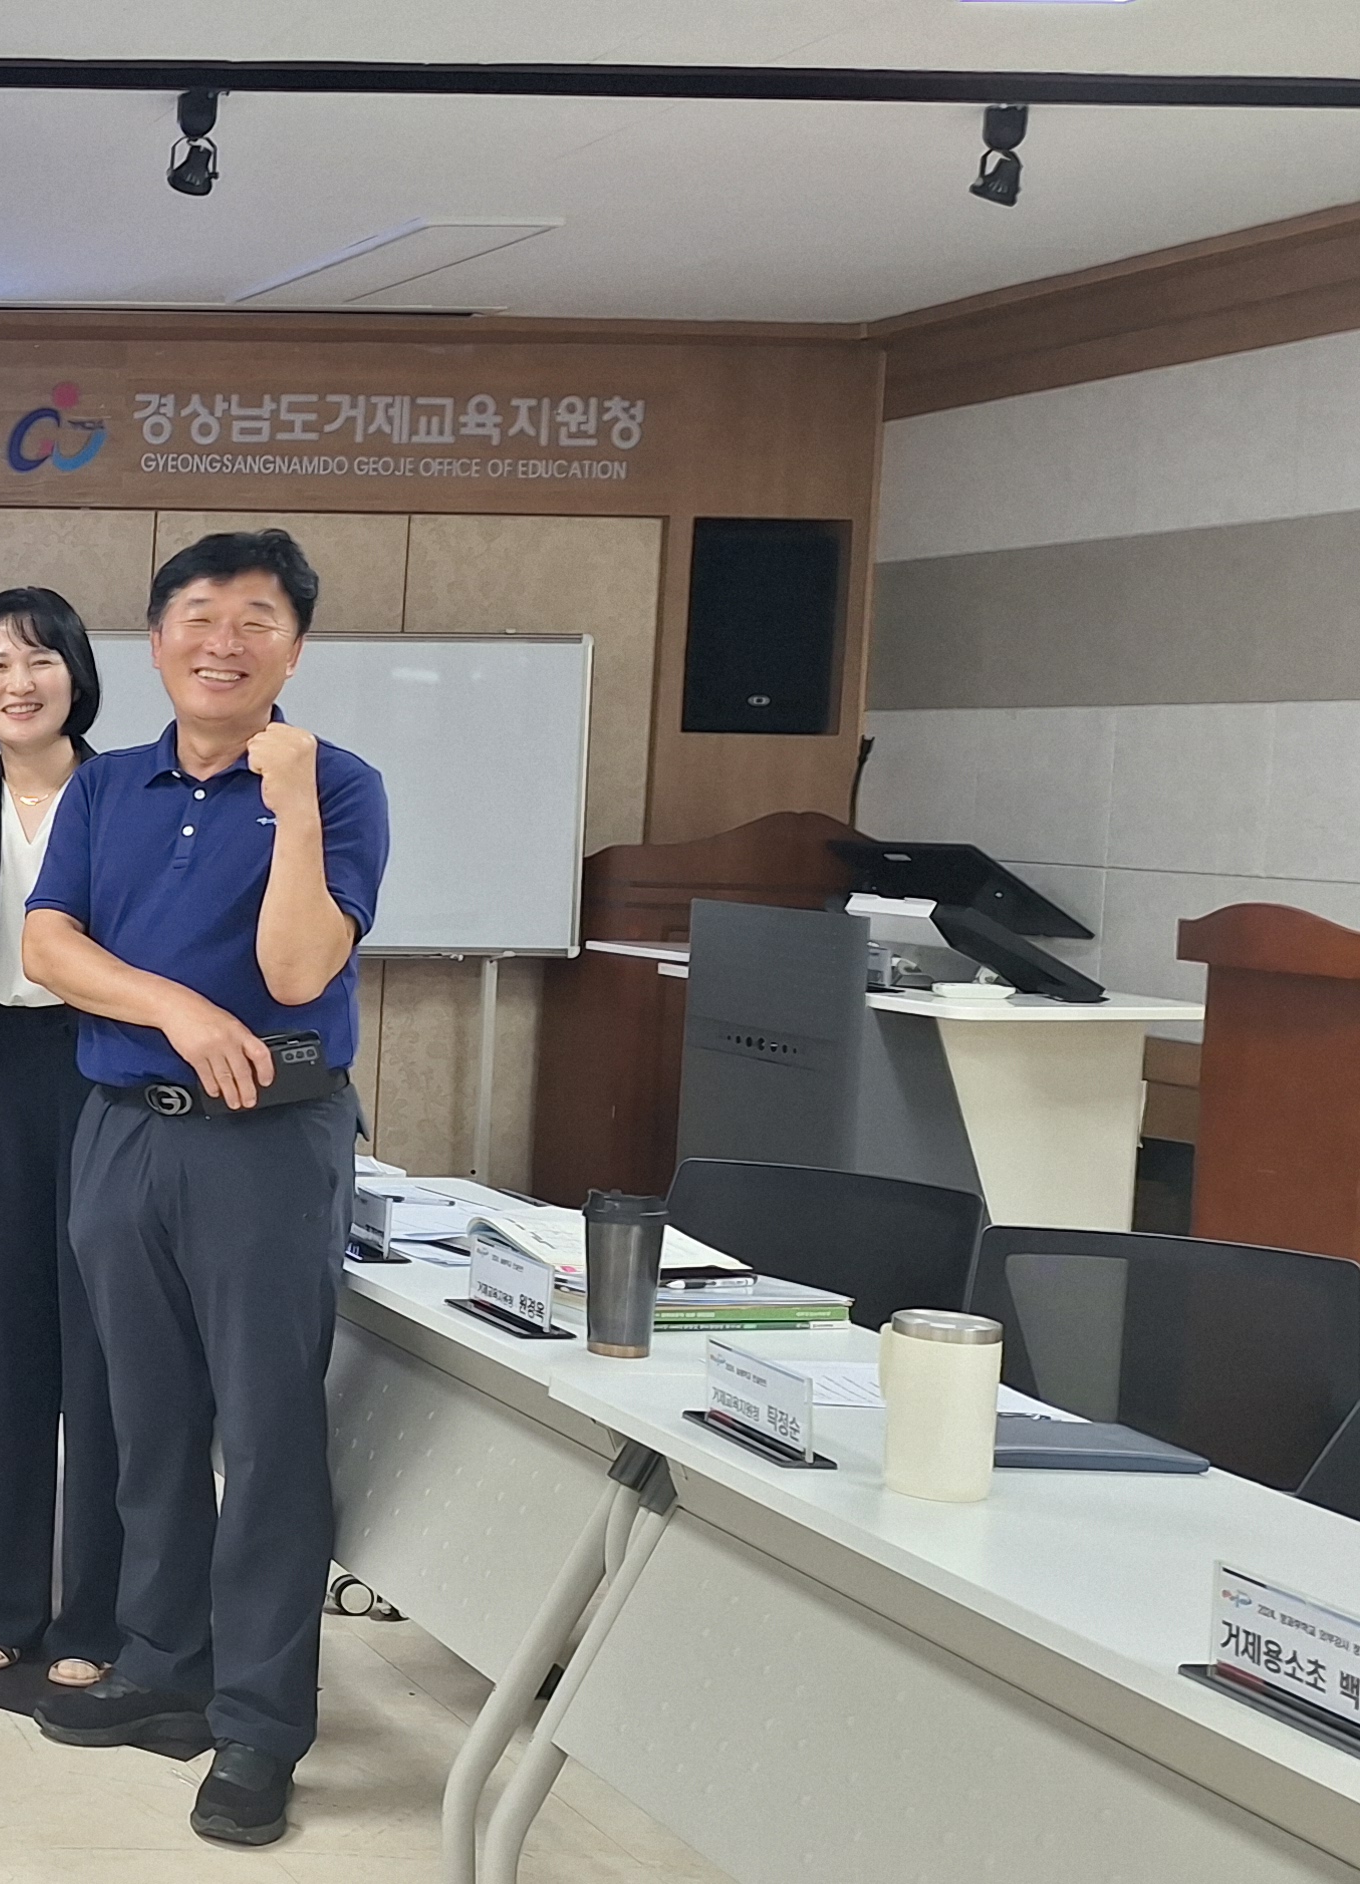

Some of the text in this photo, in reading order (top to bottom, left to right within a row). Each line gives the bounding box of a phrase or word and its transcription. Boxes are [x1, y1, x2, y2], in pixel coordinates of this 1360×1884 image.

[134, 394, 645, 450] 경상남도거제교육지원청
[141, 453, 627, 480] GYEONGSANGNAMDO GEOJE OFFICE OF EDUCATION
[767, 1404, 800, 1442] 탁정순
[1220, 1620, 1326, 1694] 거제용소초
